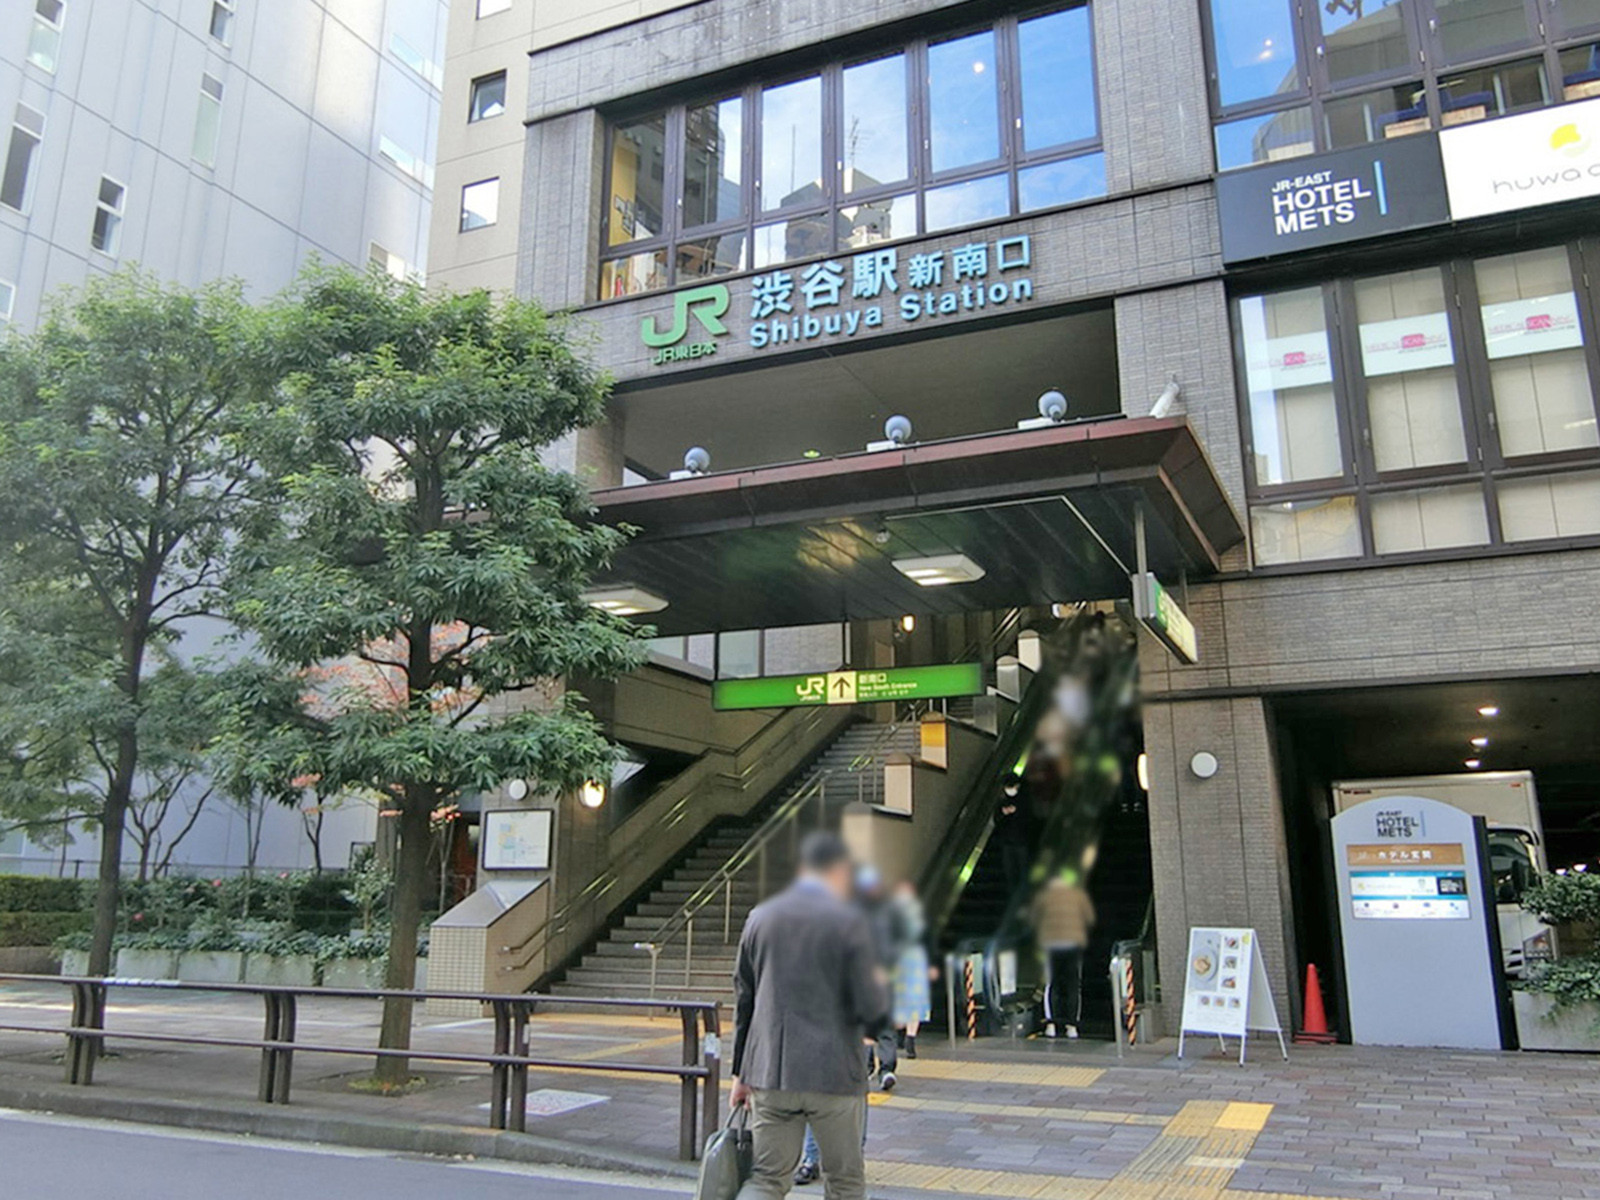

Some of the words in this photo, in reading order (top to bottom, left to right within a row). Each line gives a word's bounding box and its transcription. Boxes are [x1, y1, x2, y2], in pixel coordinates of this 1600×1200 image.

[1272, 170, 1332, 193] JR-EAST
[1272, 178, 1372, 214] HOTEL
[1275, 202, 1355, 236] METS
[750, 248, 899, 319] 渋谷駅
[908, 235, 1031, 288] 新南口
[641, 284, 729, 348] JR
[750, 305, 882, 348] Shibuya
[900, 278, 1032, 321] Station
[796, 677, 825, 695] JR
[1375, 816, 1419, 828] HOTEL
[1377, 827, 1413, 838] METS
